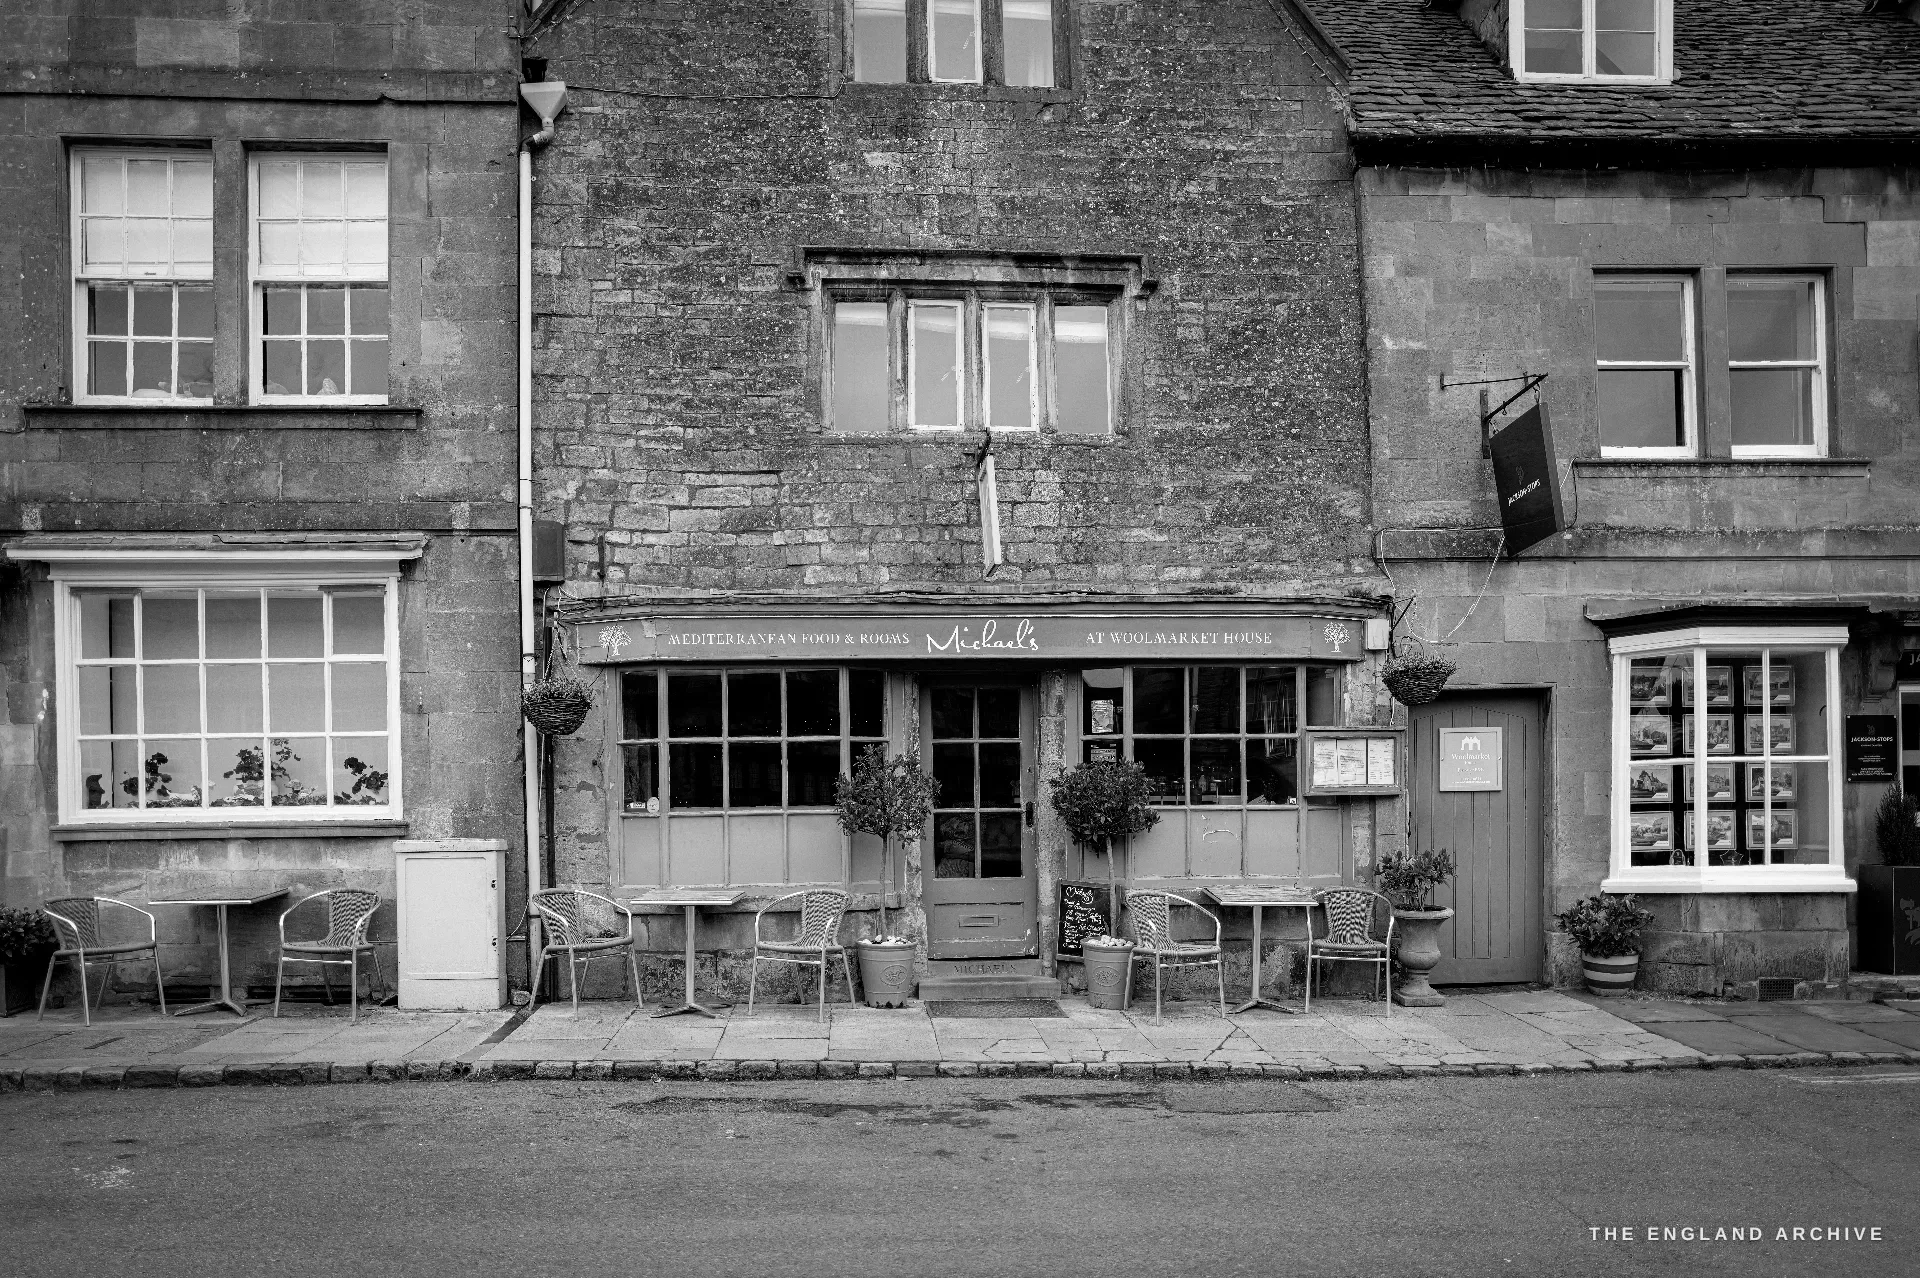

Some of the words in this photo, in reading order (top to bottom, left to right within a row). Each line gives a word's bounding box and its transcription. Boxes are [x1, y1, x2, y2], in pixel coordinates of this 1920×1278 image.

[668, 633, 796, 645] MEDITERRANEAN
[802, 633, 840, 645] FOOD
[844, 633, 855, 644] &
[860, 633, 910, 644] ROOMS
[926, 618, 1039, 654] Michael's
[1085, 631, 1105, 644] AT
[1110, 631, 1218, 644] WOOLMARKET
[1223, 631, 1272, 644] HOUSE
